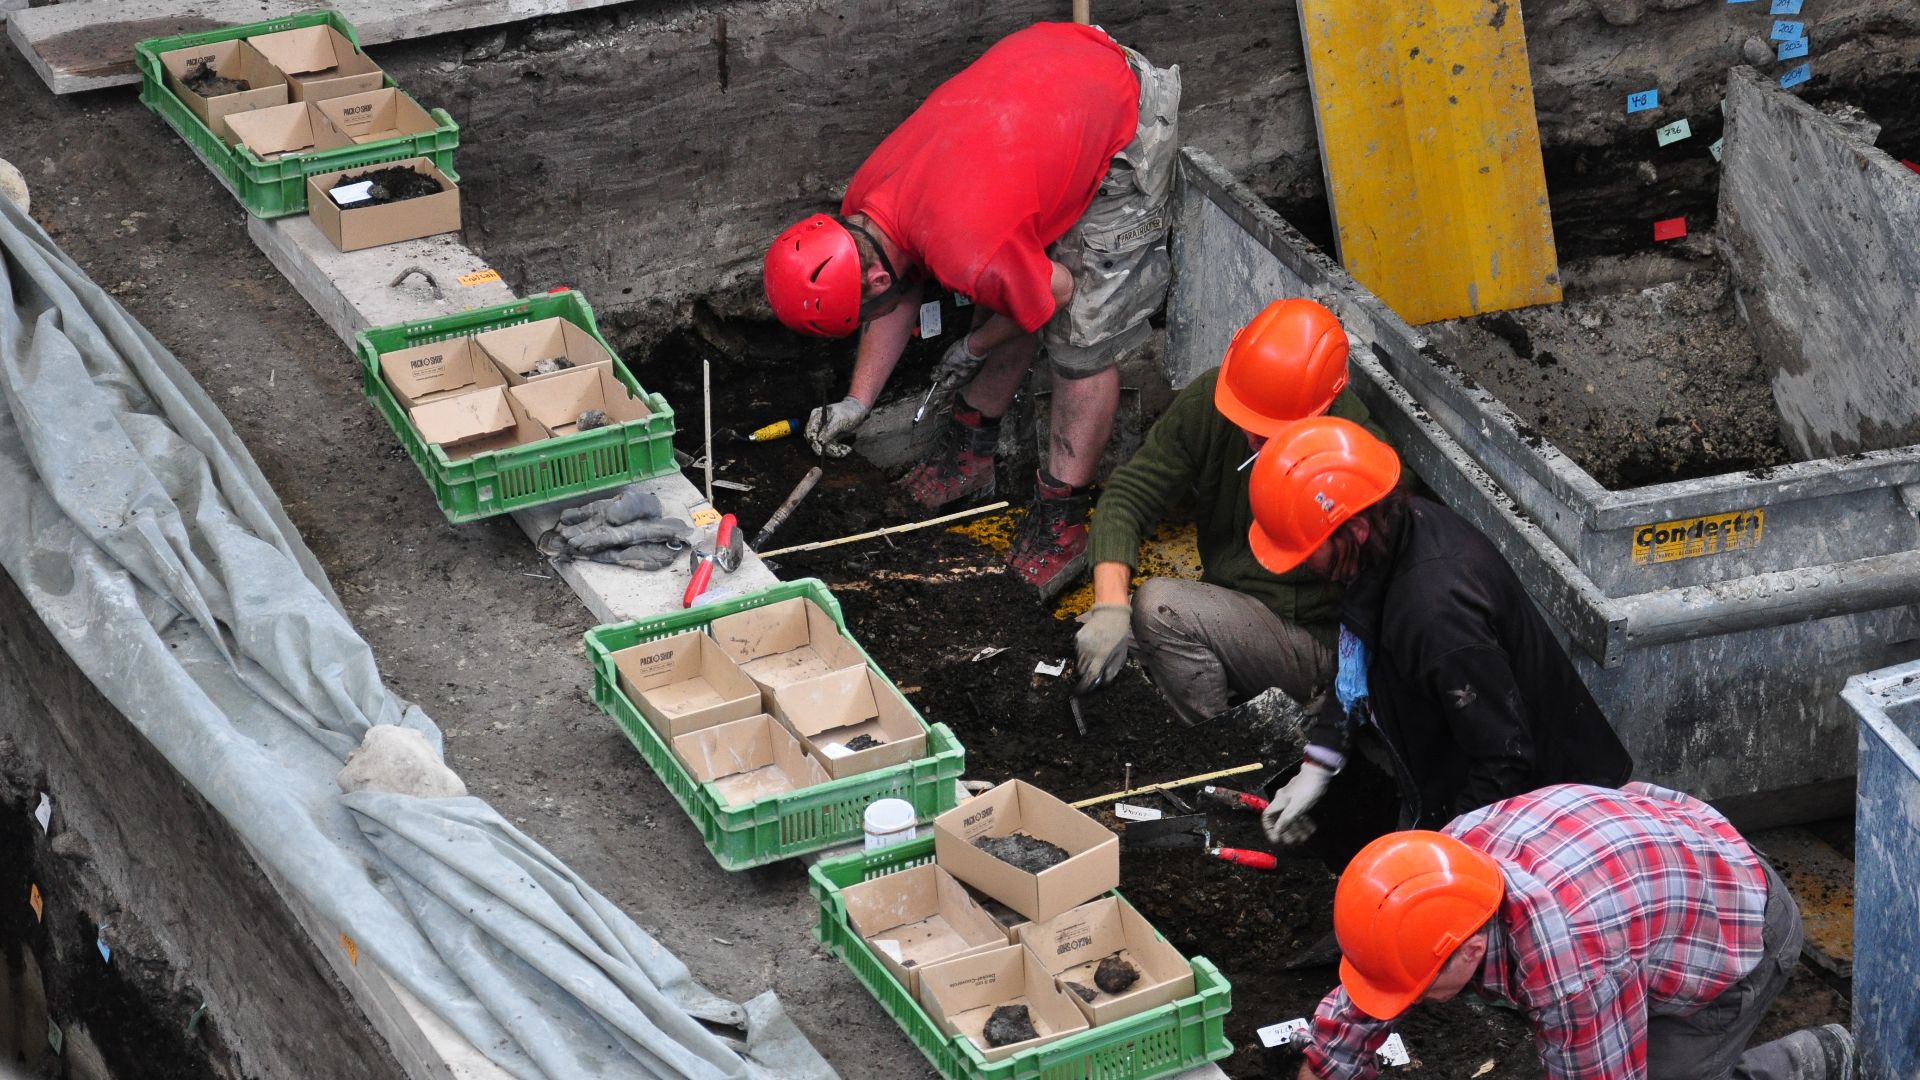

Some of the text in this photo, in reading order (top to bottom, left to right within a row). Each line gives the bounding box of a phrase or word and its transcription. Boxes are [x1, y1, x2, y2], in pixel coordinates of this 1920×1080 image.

[1779, 23, 1794, 34] 202
[1785, 40, 1802, 51] 203
[1632, 94, 1647, 107] 48
[1664, 126, 1682, 137] 736
[1636, 514, 1760, 547] Condecta
